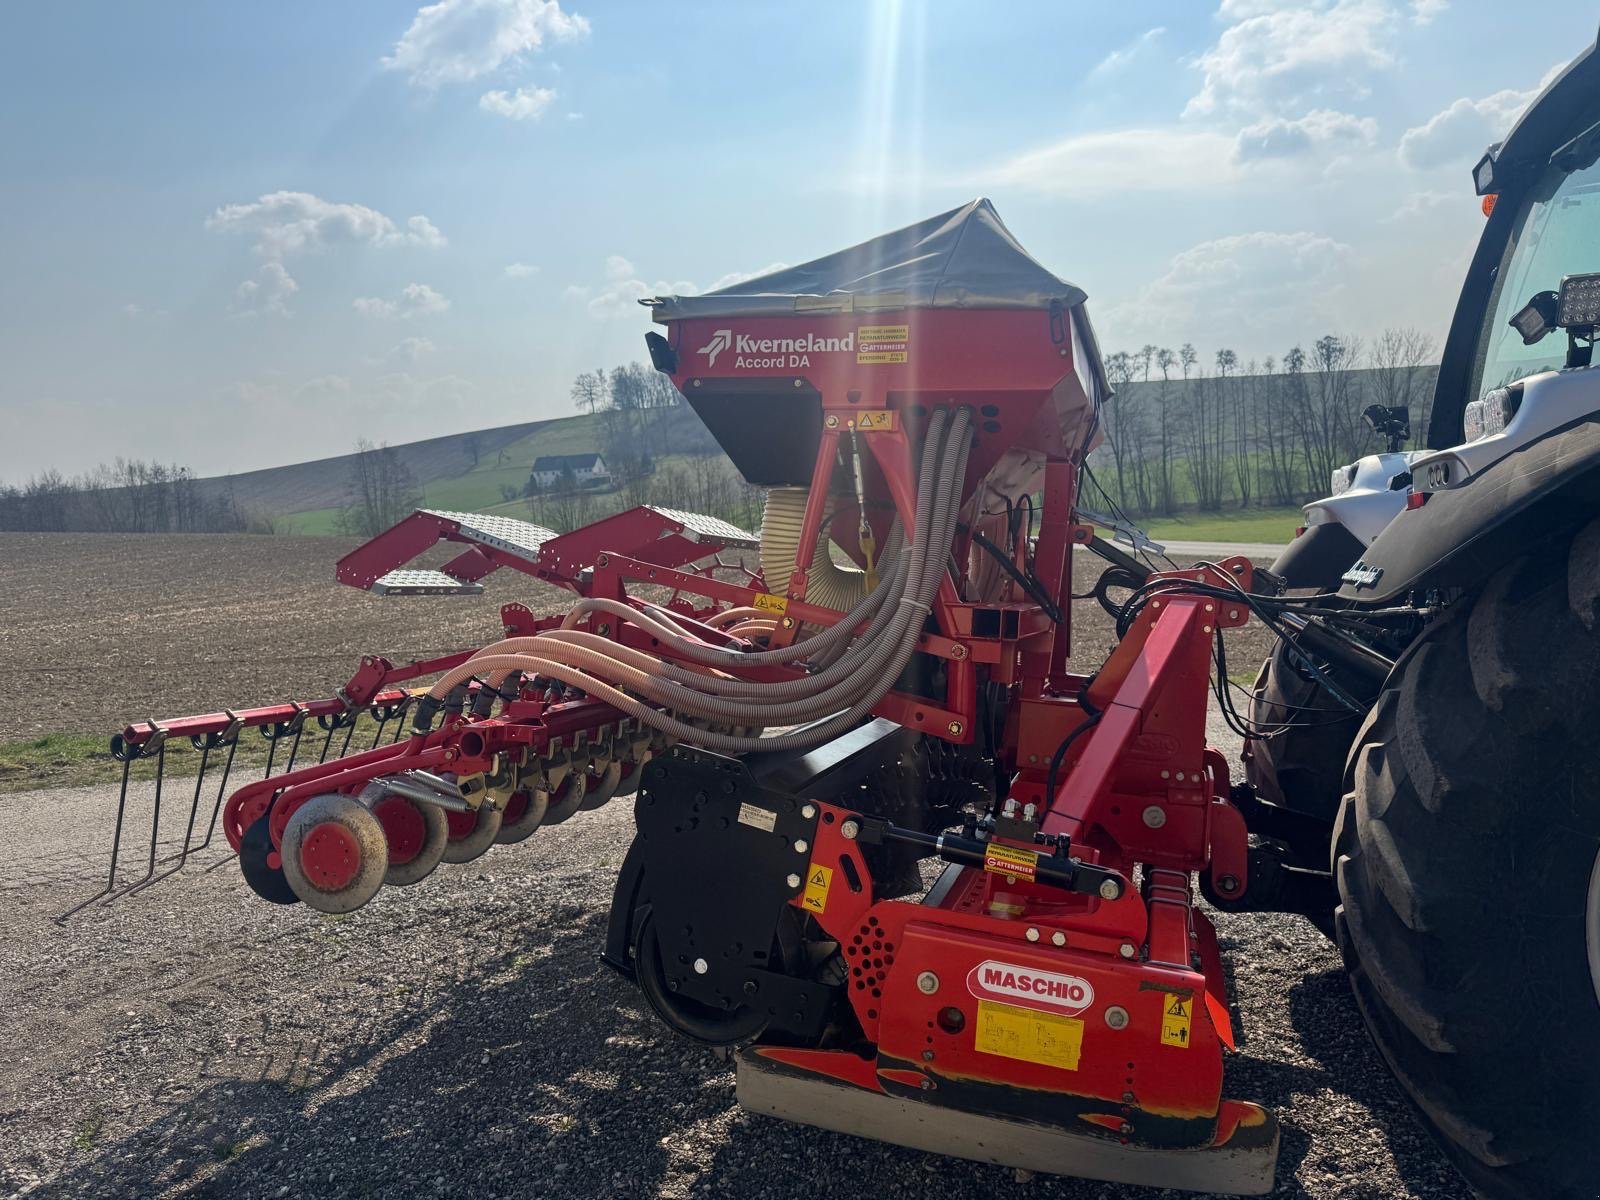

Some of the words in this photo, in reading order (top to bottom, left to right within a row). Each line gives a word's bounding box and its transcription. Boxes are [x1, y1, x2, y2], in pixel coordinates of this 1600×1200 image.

[735, 332, 854, 353] Kverneland
[735, 355, 785, 368] Accord
[789, 355, 810, 368] DA
[987, 857, 1033, 874] GATTERMEIER
[984, 968, 1085, 1001] MASCHIO
